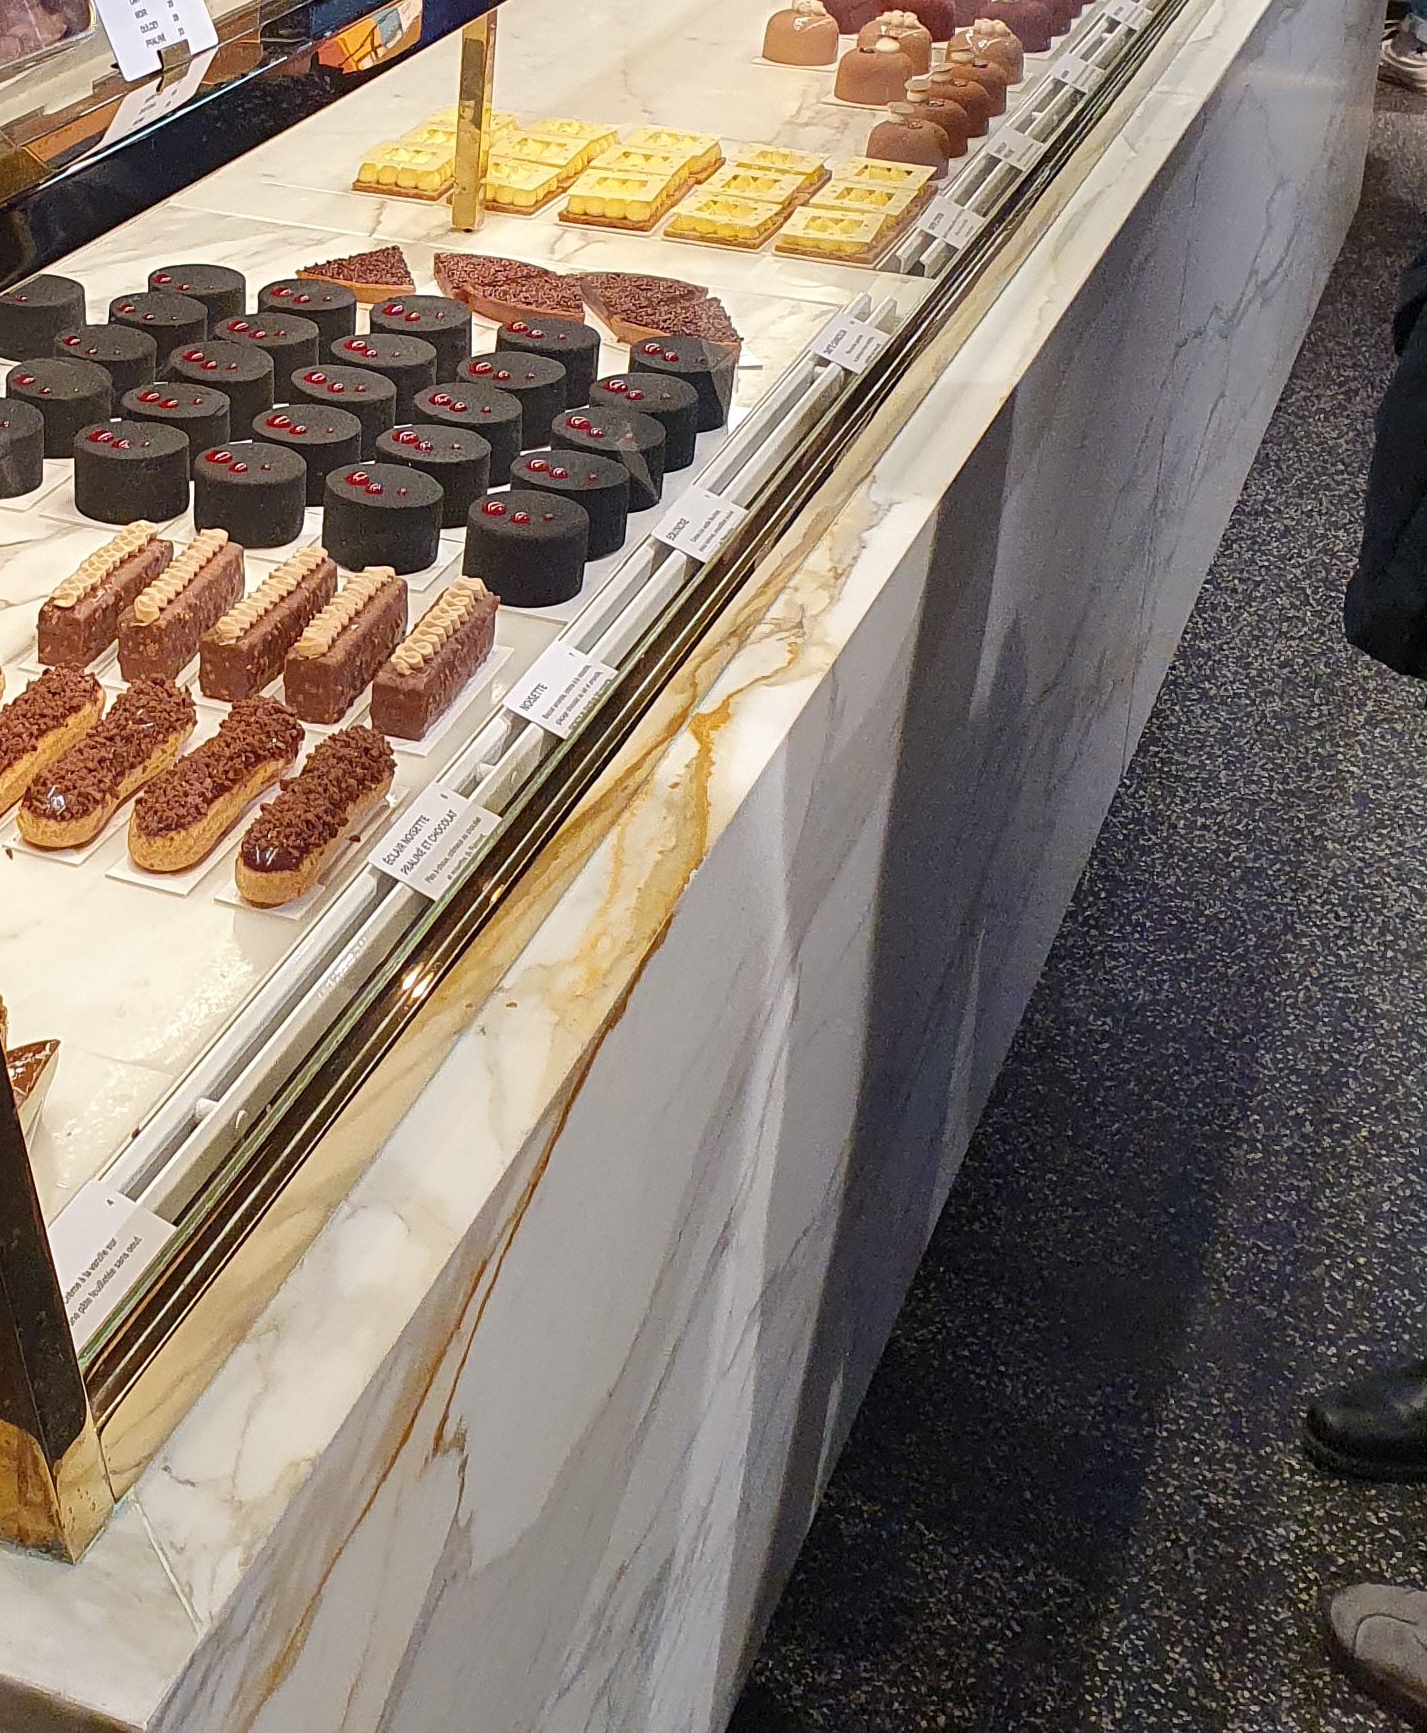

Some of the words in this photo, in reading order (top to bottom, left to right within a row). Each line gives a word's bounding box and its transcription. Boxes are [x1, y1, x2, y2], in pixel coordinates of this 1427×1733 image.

[519, 683, 548, 711] NOISETTE
[401, 846, 426, 875] PRALINÉ
[428, 809, 457, 843] CHOCOLAT
[402, 815, 430, 846] NOISETTE
